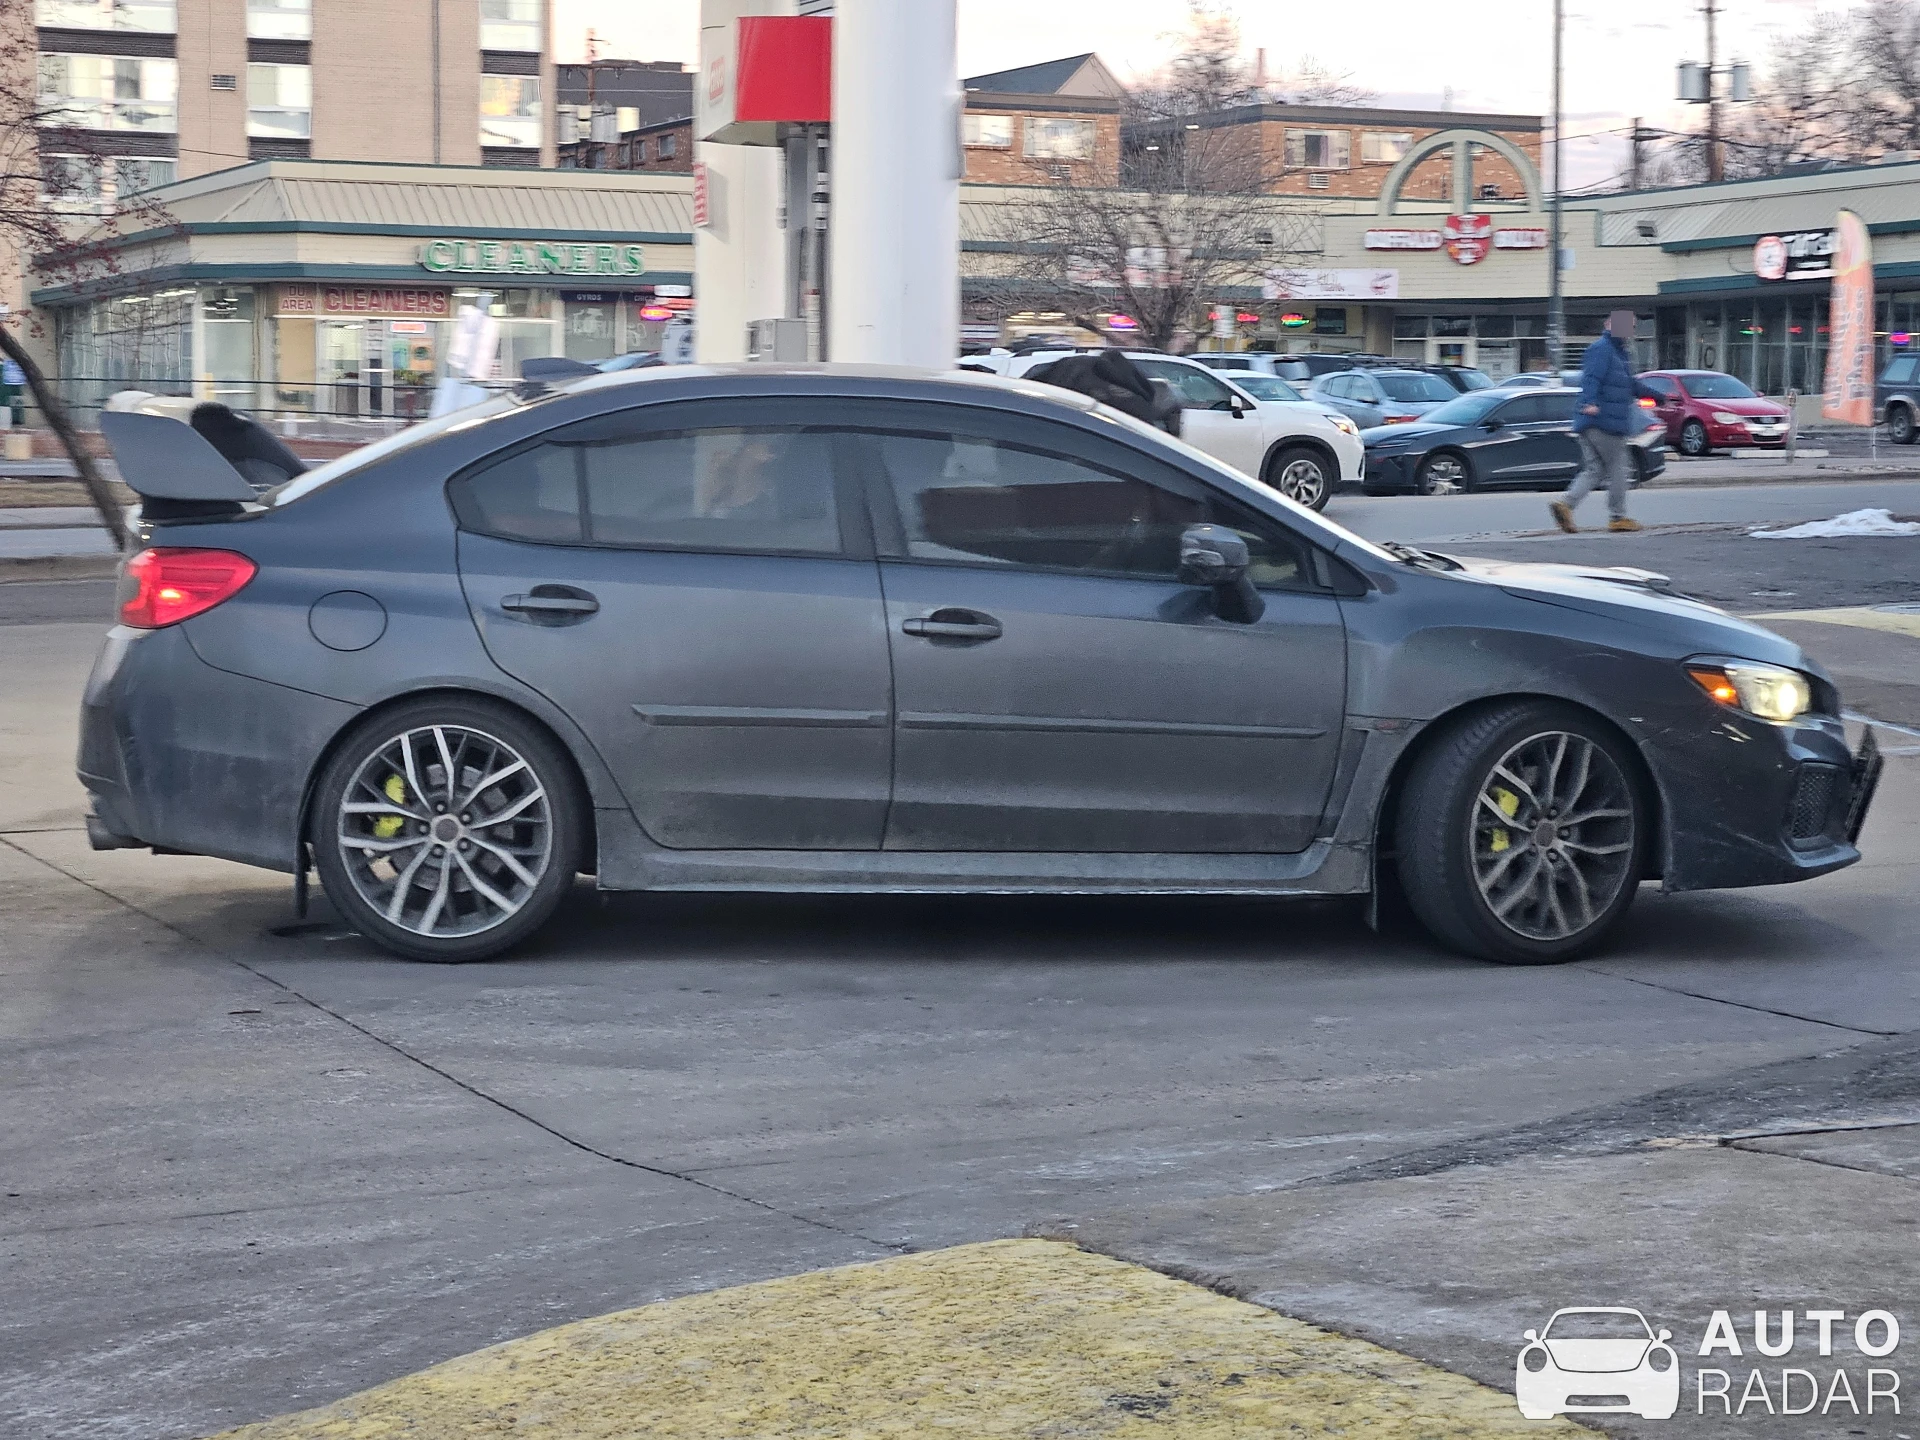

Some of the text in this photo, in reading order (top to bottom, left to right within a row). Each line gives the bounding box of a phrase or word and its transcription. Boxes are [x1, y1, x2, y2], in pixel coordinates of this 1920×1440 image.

[421, 240, 645, 276] CLEANERS
[281, 299, 314, 311] AREA
[324, 287, 447, 314] CLEANERS
[576, 293, 602, 301] GYROS
